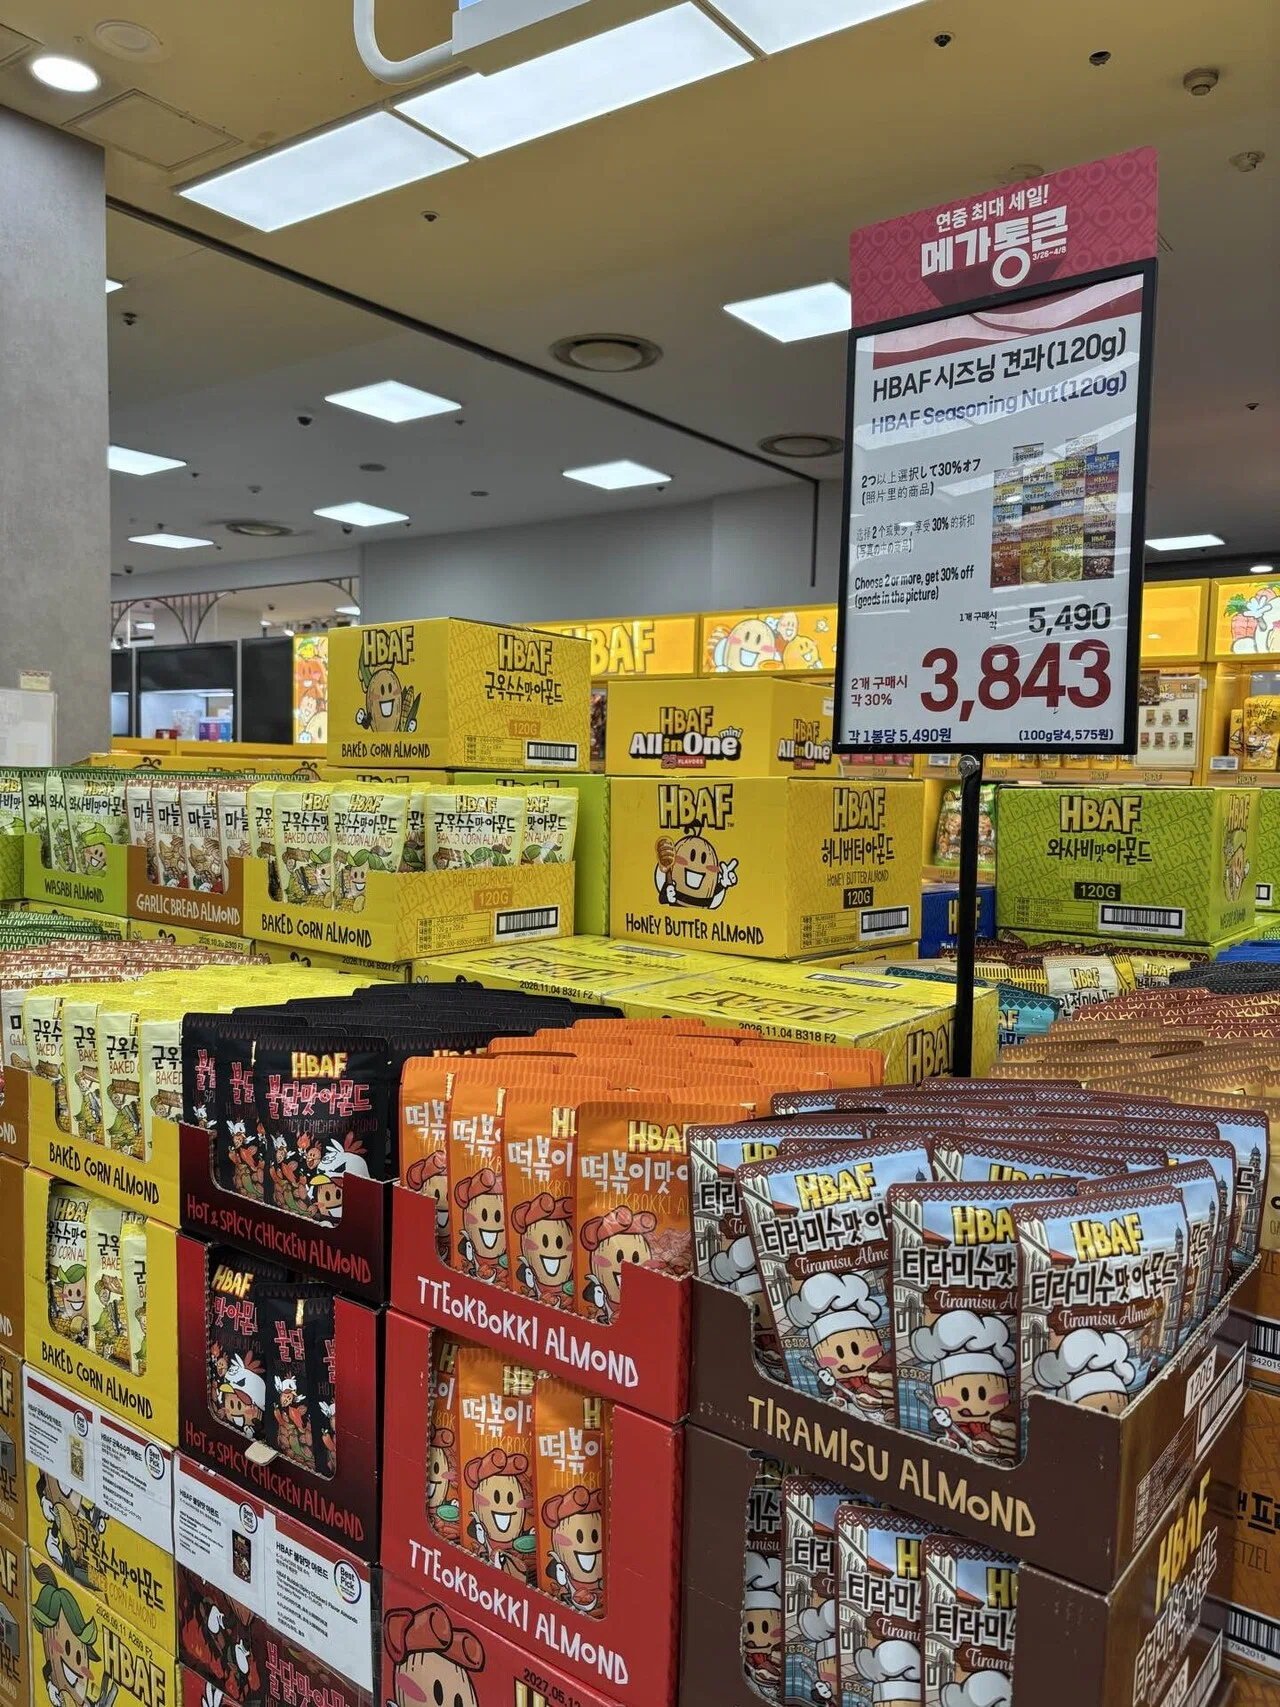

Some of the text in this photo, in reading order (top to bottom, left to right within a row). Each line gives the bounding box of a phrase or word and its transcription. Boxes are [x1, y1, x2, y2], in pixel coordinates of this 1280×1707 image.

[936, 183, 1049, 232] 연중 최대 세일!
[921, 205, 1068, 288] 메가통큰
[873, 327, 1127, 403] HBAF 시즈닝 견과(120g)
[871, 370, 1127, 435] HBAF Seasoning Nut(120g)
[855, 564, 975, 590] Choose 2 or more, get 30% off
[855, 586, 940, 609] (goods in the picture)
[1029, 602, 1111, 636] 5,490
[362, 626, 414, 667] HBAF
[497, 633, 553, 676] HBAF
[484, 670, 564, 706] 군옥수수맛아몬드
[851, 675, 909, 690] 2개 구매시
[920, 639, 1112, 722] 3,843
[851, 693, 892, 707] 각 30%
[513, 722, 538, 735] 120G
[659, 706, 714, 735] HBAF
[719, 726, 743, 738] mini
[793, 718, 820, 742] HBAF
[341, 740, 431, 759] BAKED CORN ALMOND
[848, 728, 952, 744] 각 1봉당 5,490원
[677, 758, 705, 766] FLAVORS
[347, 794, 384, 813] HBAF
[456, 795, 498, 813] HBAF
[657, 783, 733, 830] HBAF
[833, 787, 886, 832] HBAF
[1059, 795, 1142, 833] HBAF
[1227, 793, 1250, 832] HBAF
[334, 811, 398, 835] 군옥수수맛아몬드
[434, 811, 516, 834] 군옥수수맛아몬드
[284, 831, 329, 845] BAKED CORN
[821, 832, 895, 865] 허니버터아몬드
[1046, 836, 1153, 866] 와사비맛아몬드
[44, 879, 105, 903] WASABI ALMOND
[478, 892, 509, 906] 120G
[846, 890, 871, 905] 120G
[1078, 885, 1116, 898] 120G
[136, 893, 241, 926] GARLIC BREAD ALMOND
[261, 913, 373, 948] BAKED CORN ALMOND
[625, 913, 764, 945] HONEY BUTTER ALMOND
[519, 981, 594, 1000] 2026.11.04 B321 F2
[1070, 967, 1100, 989] HBAF
[795, 1030, 822, 1043] B318
[824, 1033, 837, 1044] F2
[109, 1060, 135, 1075] BAKED
[291, 1051, 348, 1079] HBAF
[265, 1074, 372, 1119] 불닭맛아몬드
[49, 1141, 160, 1206] BAKED CORN ALMOND
[794, 1161, 876, 1212] HBAF
[186, 1193, 209, 1220] HOT
[219, 1209, 252, 1240] SPICY
[254, 1223, 307, 1259] CHICKEN
[309, 1240, 372, 1284] ALMOND
[1070, 1212, 1144, 1264] HBAF
[794, 1256, 854, 1276] Tiramisu
[212, 1264, 254, 1299] HBAF
[935, 1288, 997, 1310] Tiramisu
[417, 1275, 639, 1388] TTEOKBOKKI ALMOND
[1057, 1306, 1117, 1329] Tiramisu
[41, 1340, 153, 1420] BAKED CORN ALMOND
[185, 1420, 206, 1448] HOT
[216, 1442, 249, 1479] SPICY
[251, 1464, 301, 1508] CHICKEN
[304, 1489, 364, 1542] ALMOND
[747, 1395, 889, 1482] TIRAMISU
[899, 1458, 1037, 1538] ALMOND
[1154, 1468, 1212, 1616] HBAF
[340, 1566, 355, 1582] Best
[340, 1575, 355, 1591] Pick
[408, 1538, 529, 1632] TTEOKBOKKI
[535, 1612, 630, 1686] ALMOND
[102, 1623, 166, 1707] HBAF
